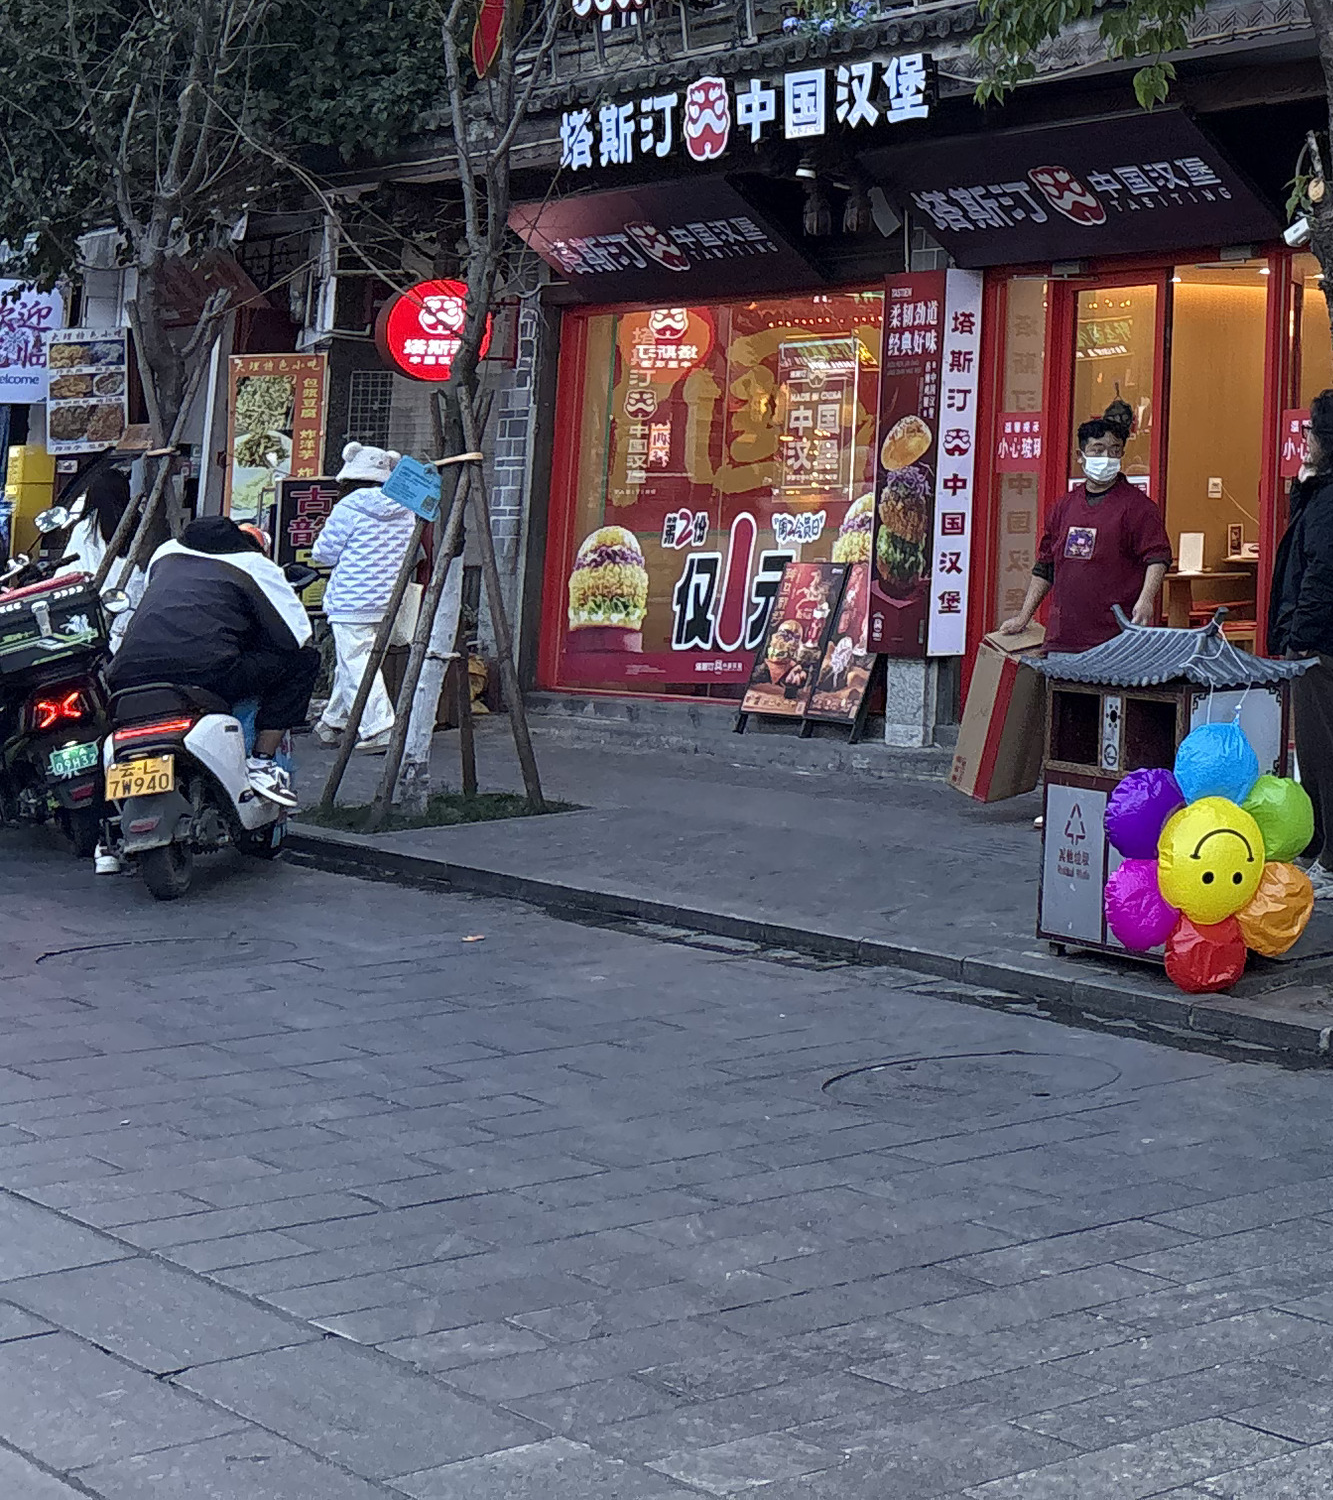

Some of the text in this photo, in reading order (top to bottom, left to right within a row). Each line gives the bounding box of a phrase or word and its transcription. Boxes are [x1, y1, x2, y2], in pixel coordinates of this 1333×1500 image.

[559, 53, 930, 171] 塔斯汀 中国汉堡
[911, 156, 1222, 232] 塔斯汀 中国汉堡
[1110, 186, 1233, 212] TASITING
[547, 217, 769, 275] 塔斯汀 中国汉堡
[888, 300, 939, 329] 柔韧劲道
[887, 328, 938, 357] 经典好味
[0, 373, 40, 386] elcome
[234, 358, 321, 372] 大理特色小吃
[789, 403, 841, 437] 中国
[937, 311, 976, 615] 塔斯汀 中国汉堡
[663, 509, 708, 548] 第2份
[109, 773, 170, 799] 7W940
